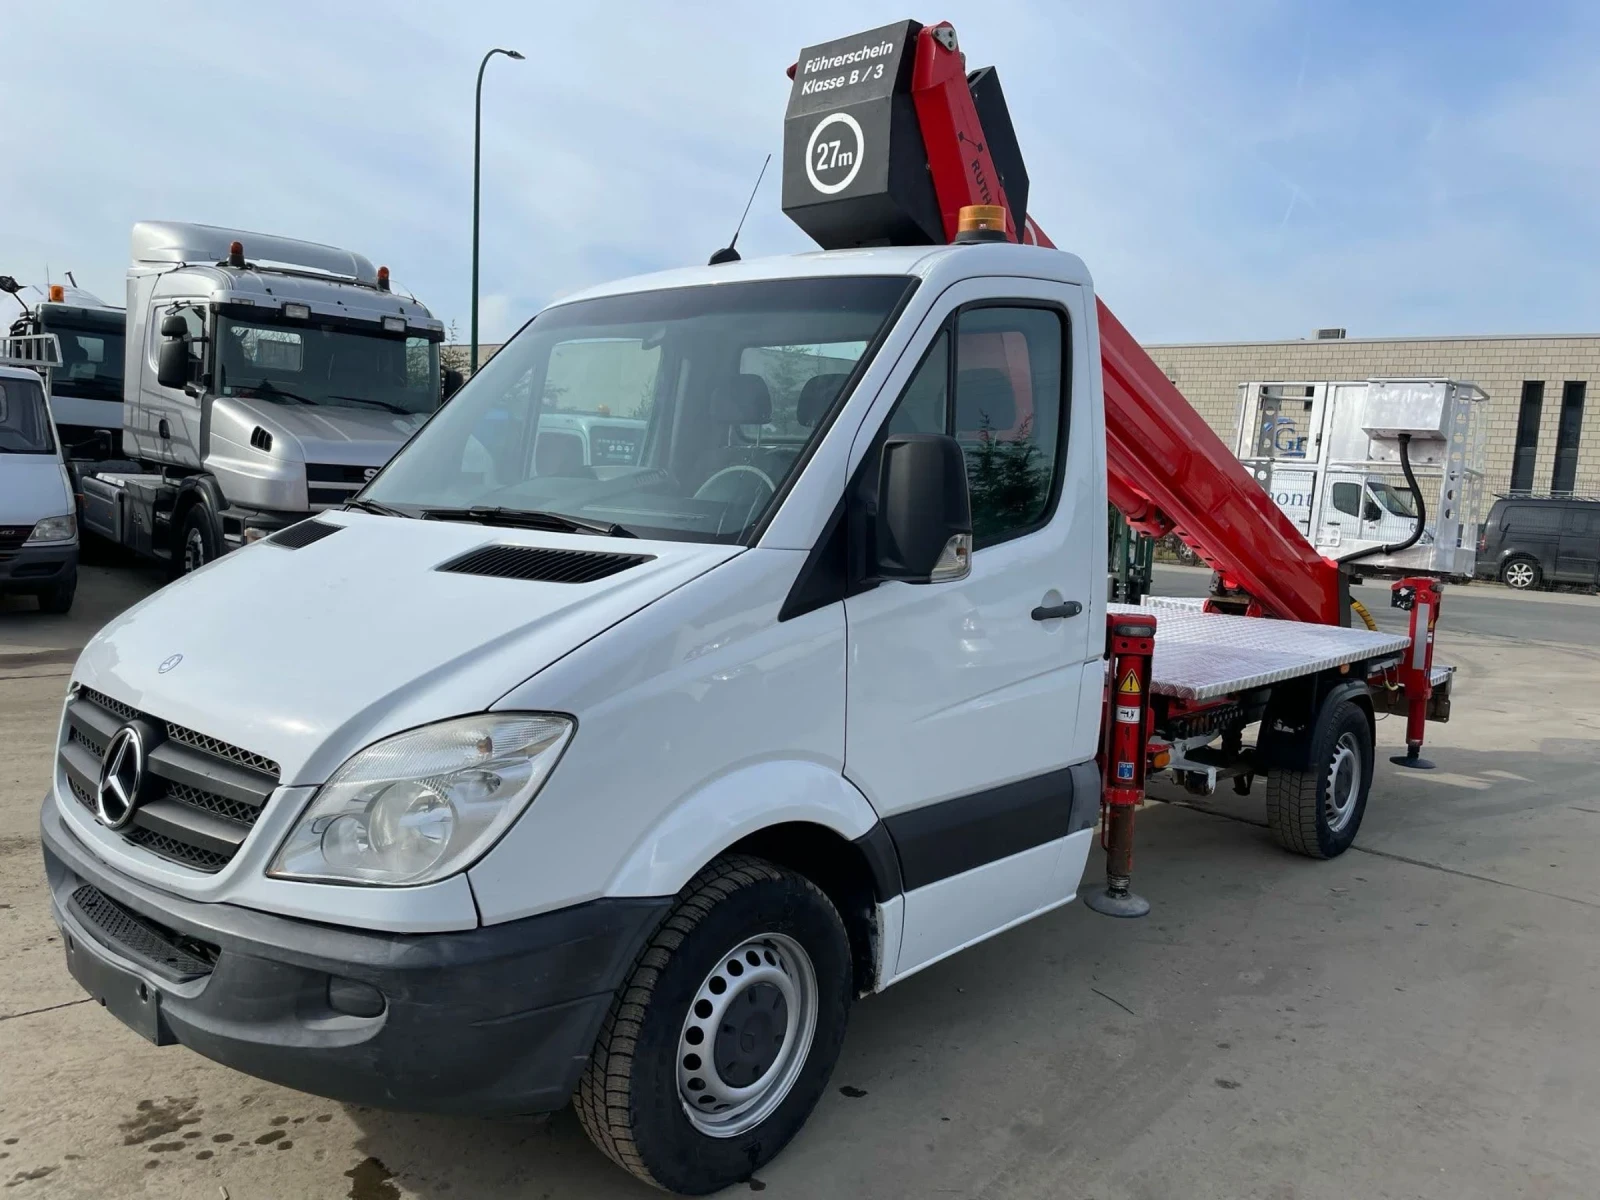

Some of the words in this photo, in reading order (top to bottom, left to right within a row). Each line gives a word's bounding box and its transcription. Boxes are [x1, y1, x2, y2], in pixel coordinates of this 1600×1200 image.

[804, 40, 894, 75] Führerschein
[801, 76, 845, 96] Klasse
[849, 69, 860, 85] B
[873, 63, 884, 80] 3
[816, 139, 853, 171] 27m
[1270, 491, 1312, 508] ont
